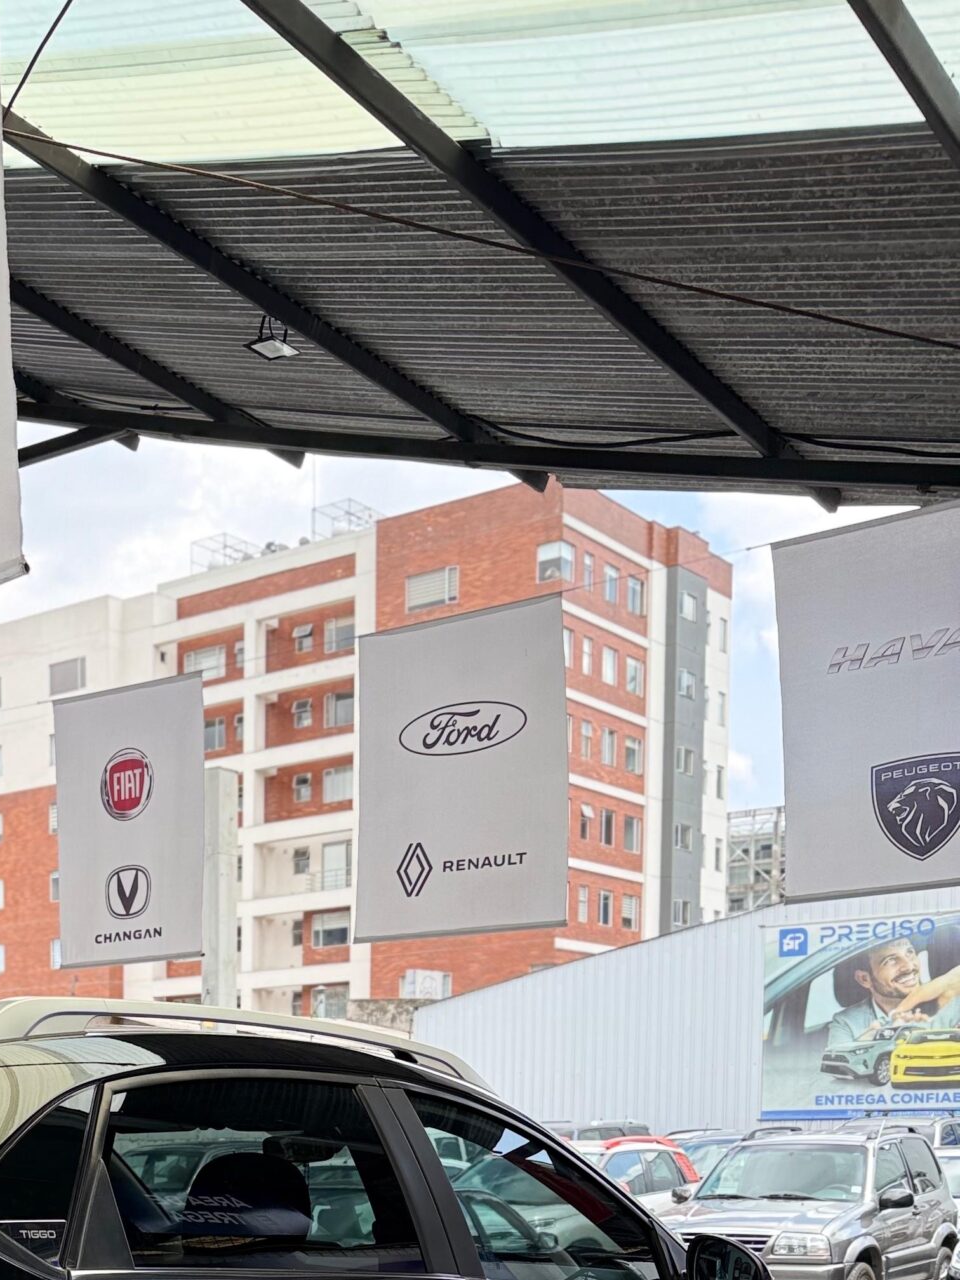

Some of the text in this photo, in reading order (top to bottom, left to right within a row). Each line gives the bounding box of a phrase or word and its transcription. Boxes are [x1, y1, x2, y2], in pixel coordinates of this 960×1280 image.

[422, 709, 501, 750] Ford
[113, 768, 143, 802] FIAT
[442, 852, 527, 873] RENAULT
[95, 926, 163, 944] CHANGAN
[819, 917, 936, 944] PRECISO
[815, 1093, 887, 1106] ENTREGA
[19, 1229, 57, 1239] TIGGO
